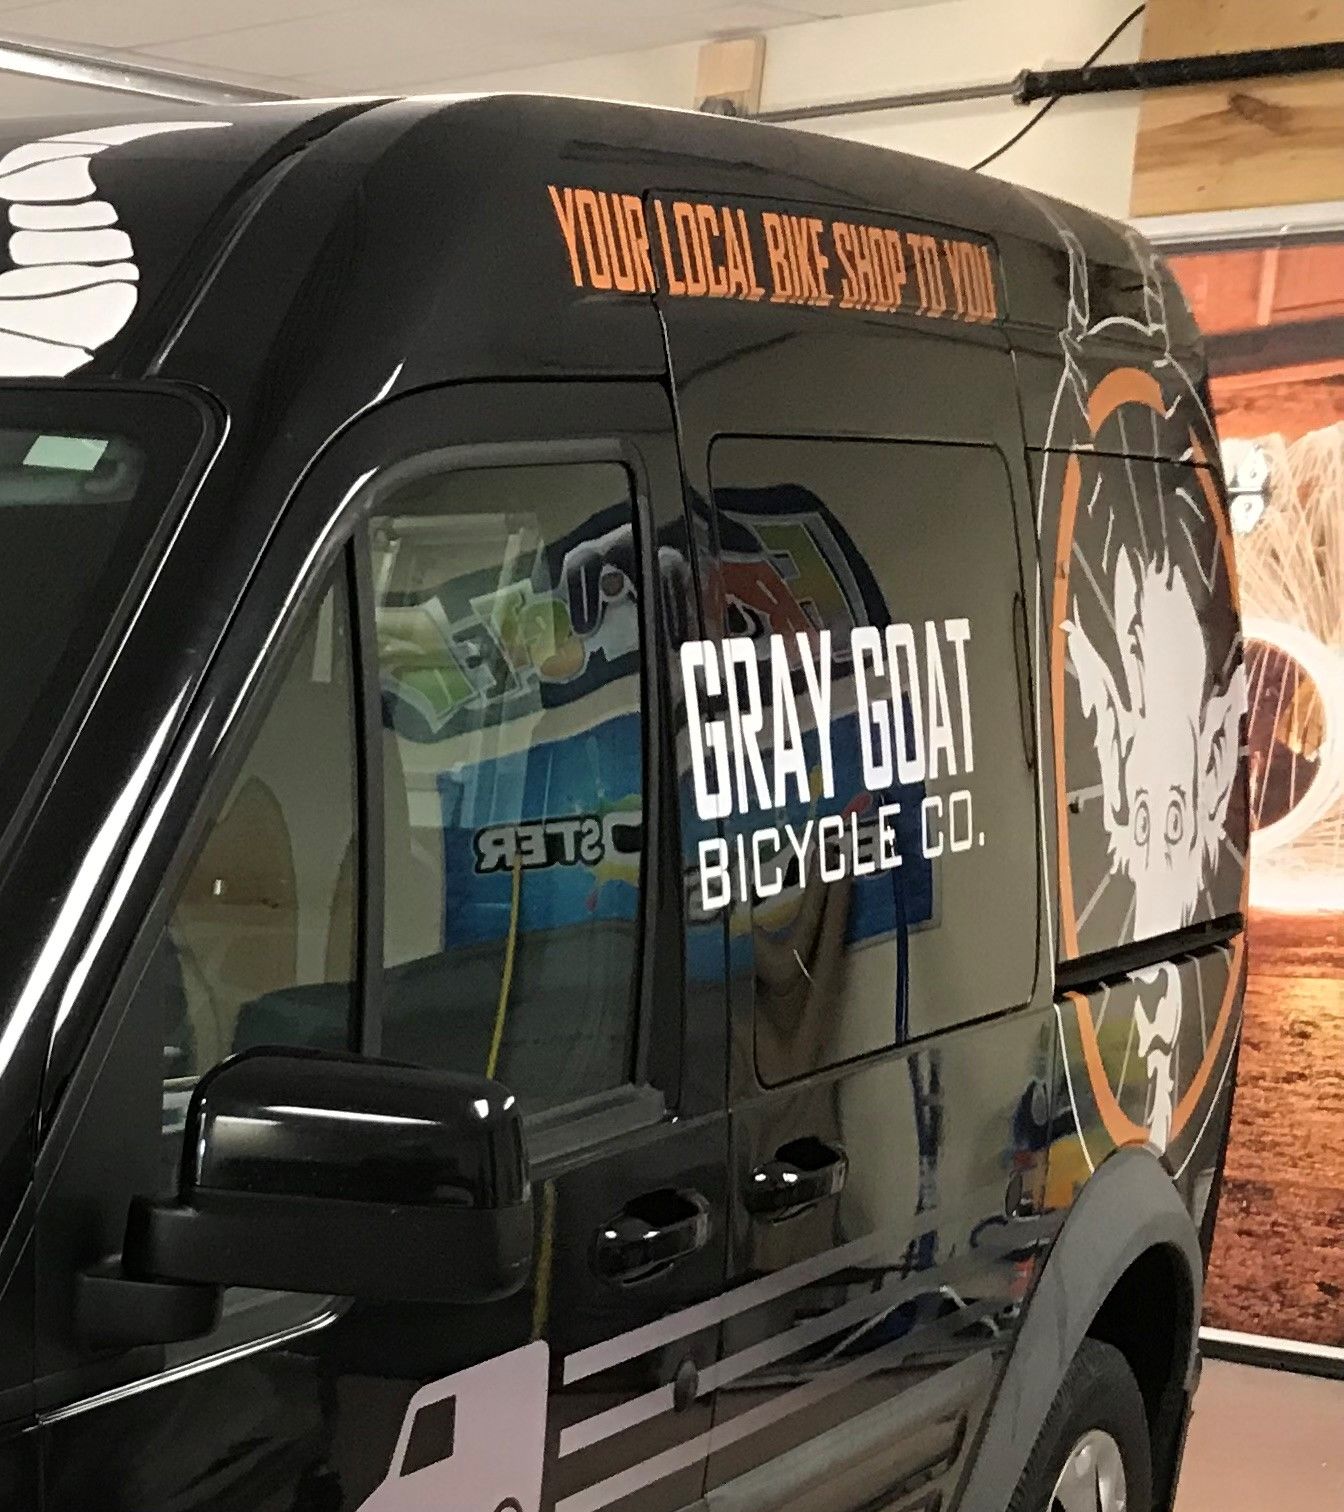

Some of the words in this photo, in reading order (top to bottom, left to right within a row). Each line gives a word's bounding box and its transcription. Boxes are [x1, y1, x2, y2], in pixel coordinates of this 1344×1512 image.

[548, 185, 656, 293] YOUR
[653, 199, 765, 301] LOCAL
[762, 211, 833, 306] BIKE
[832, 221, 907, 314] SHOP
[907, 233, 947, 317] TO
[943, 238, 998, 324] YOU
[680, 629, 835, 821] GRAY
[851, 618, 974, 791] GOAT
[698, 803, 903, 912] BICYCLE
[921, 789, 986, 859] CO.
